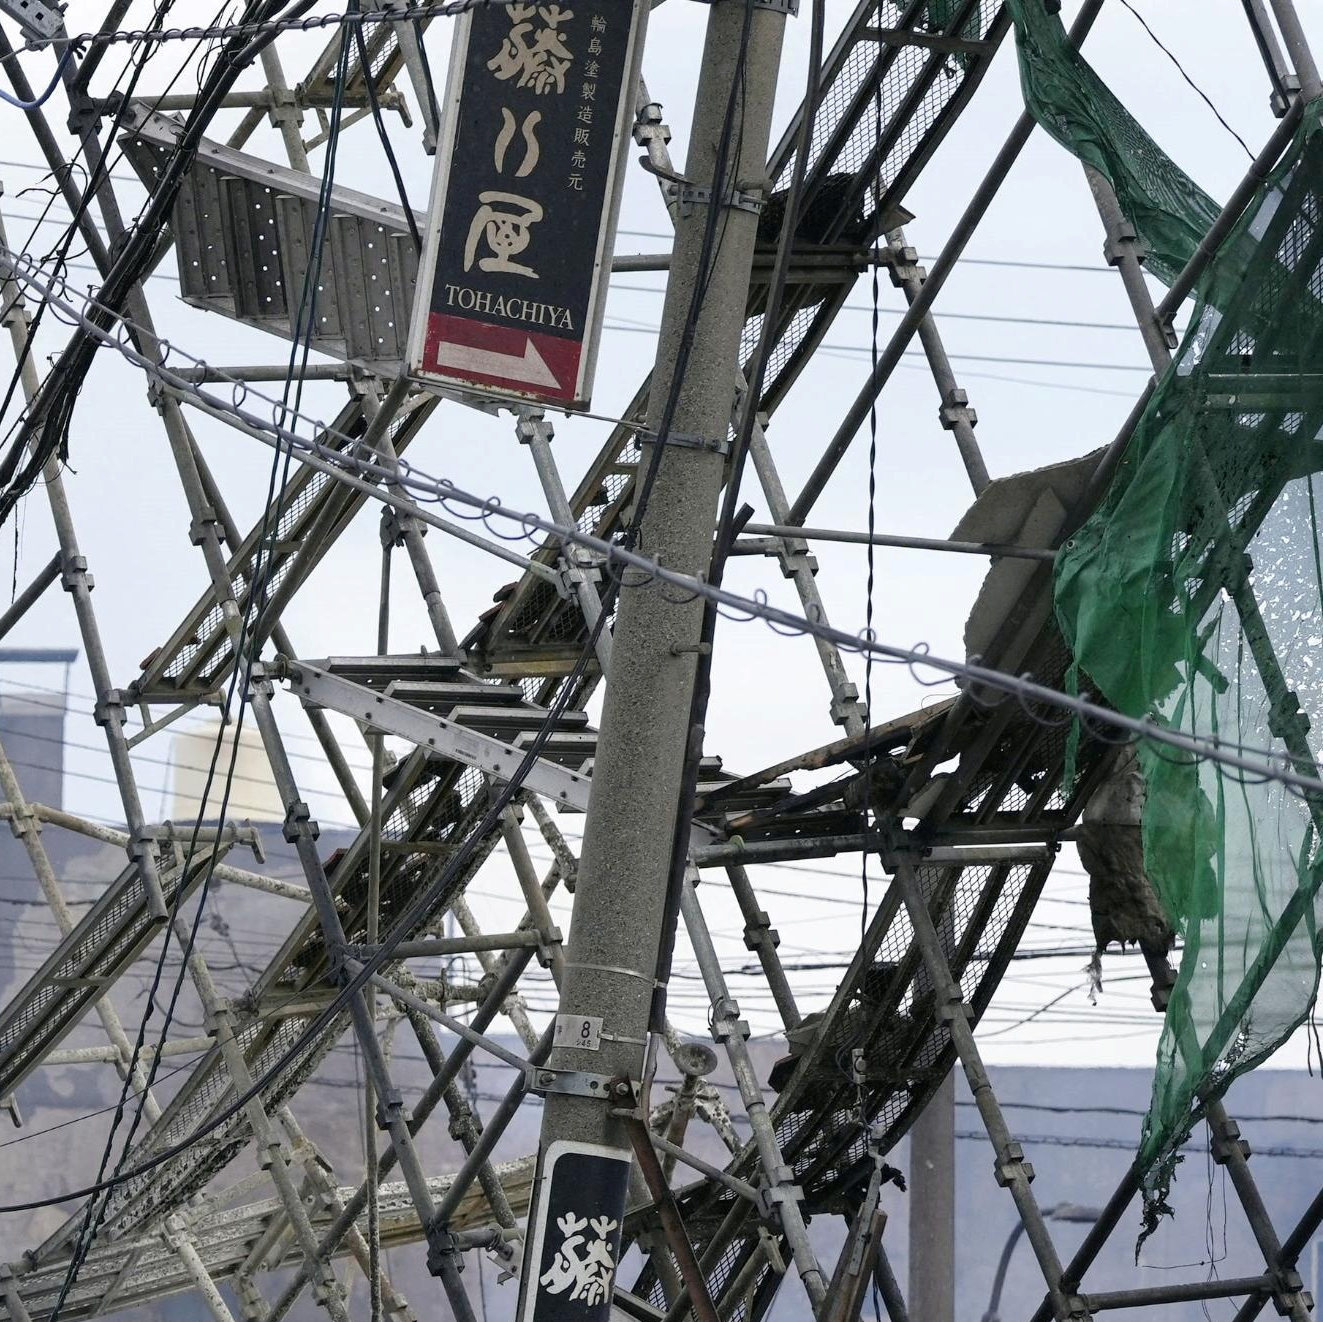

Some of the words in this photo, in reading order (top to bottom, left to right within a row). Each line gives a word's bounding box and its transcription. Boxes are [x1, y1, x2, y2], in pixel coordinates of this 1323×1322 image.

[567, 14, 607, 192] 輪島塗製造販売元
[445, 284, 574, 331] TOHACHIYA
[581, 1020, 591, 1039] 8
